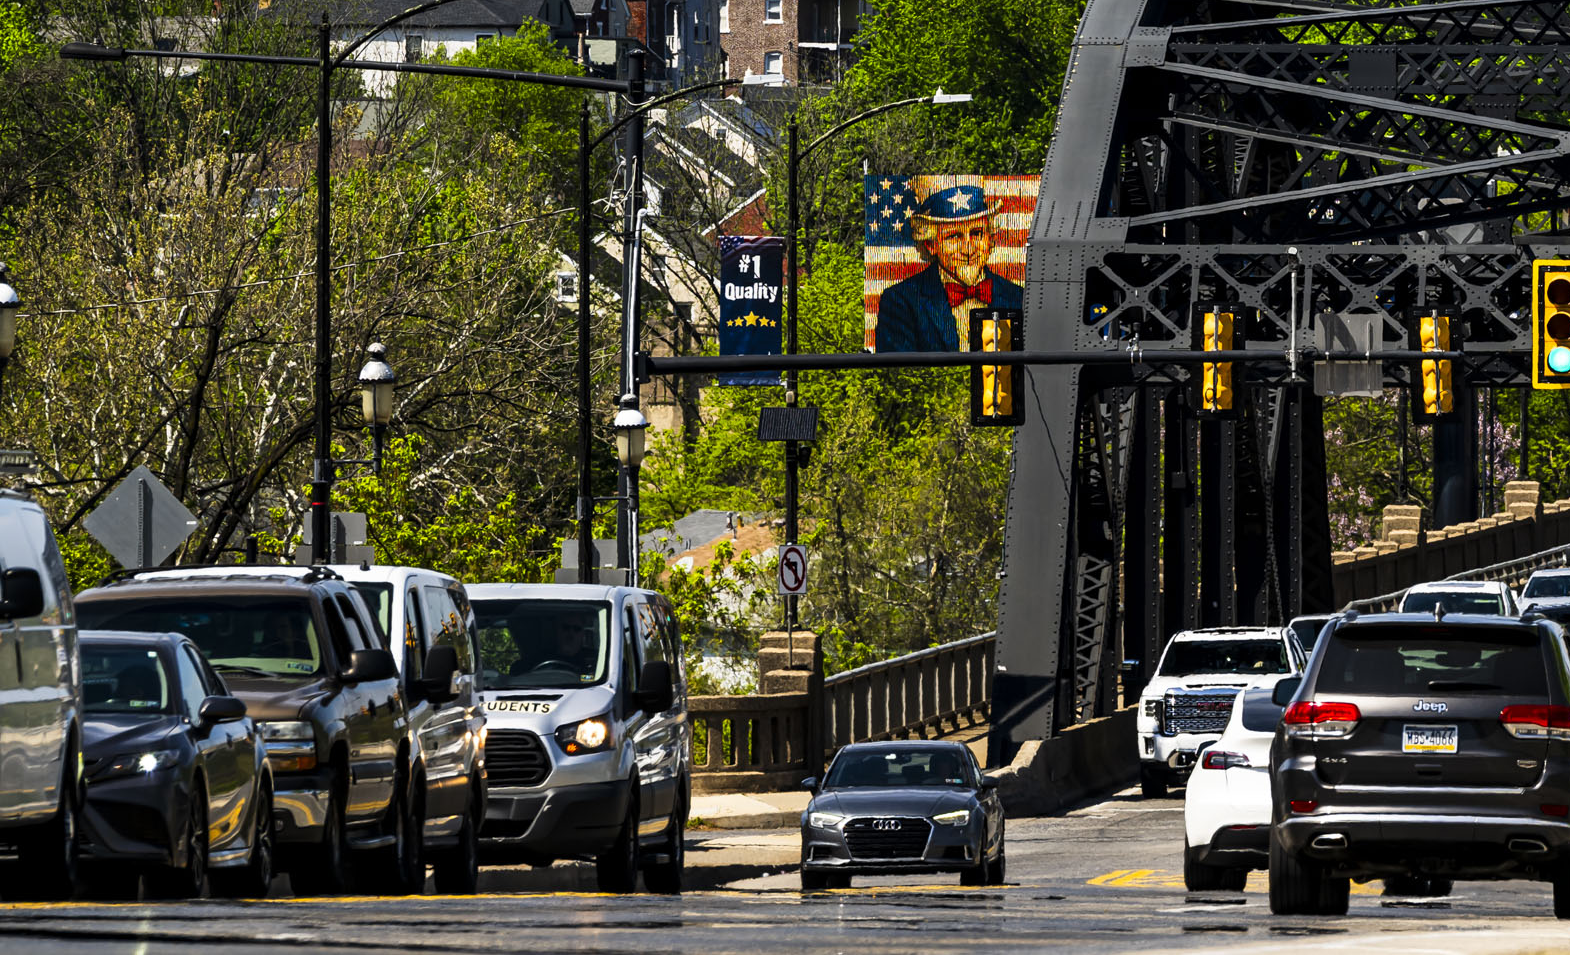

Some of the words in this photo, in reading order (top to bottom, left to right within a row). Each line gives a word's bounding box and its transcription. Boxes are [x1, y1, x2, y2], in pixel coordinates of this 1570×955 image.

[738, 254, 761, 279] #1
[724, 282, 778, 303] Quality
[481, 701, 551, 714] UDENTS
[1413, 700, 1447, 713] Jeep
